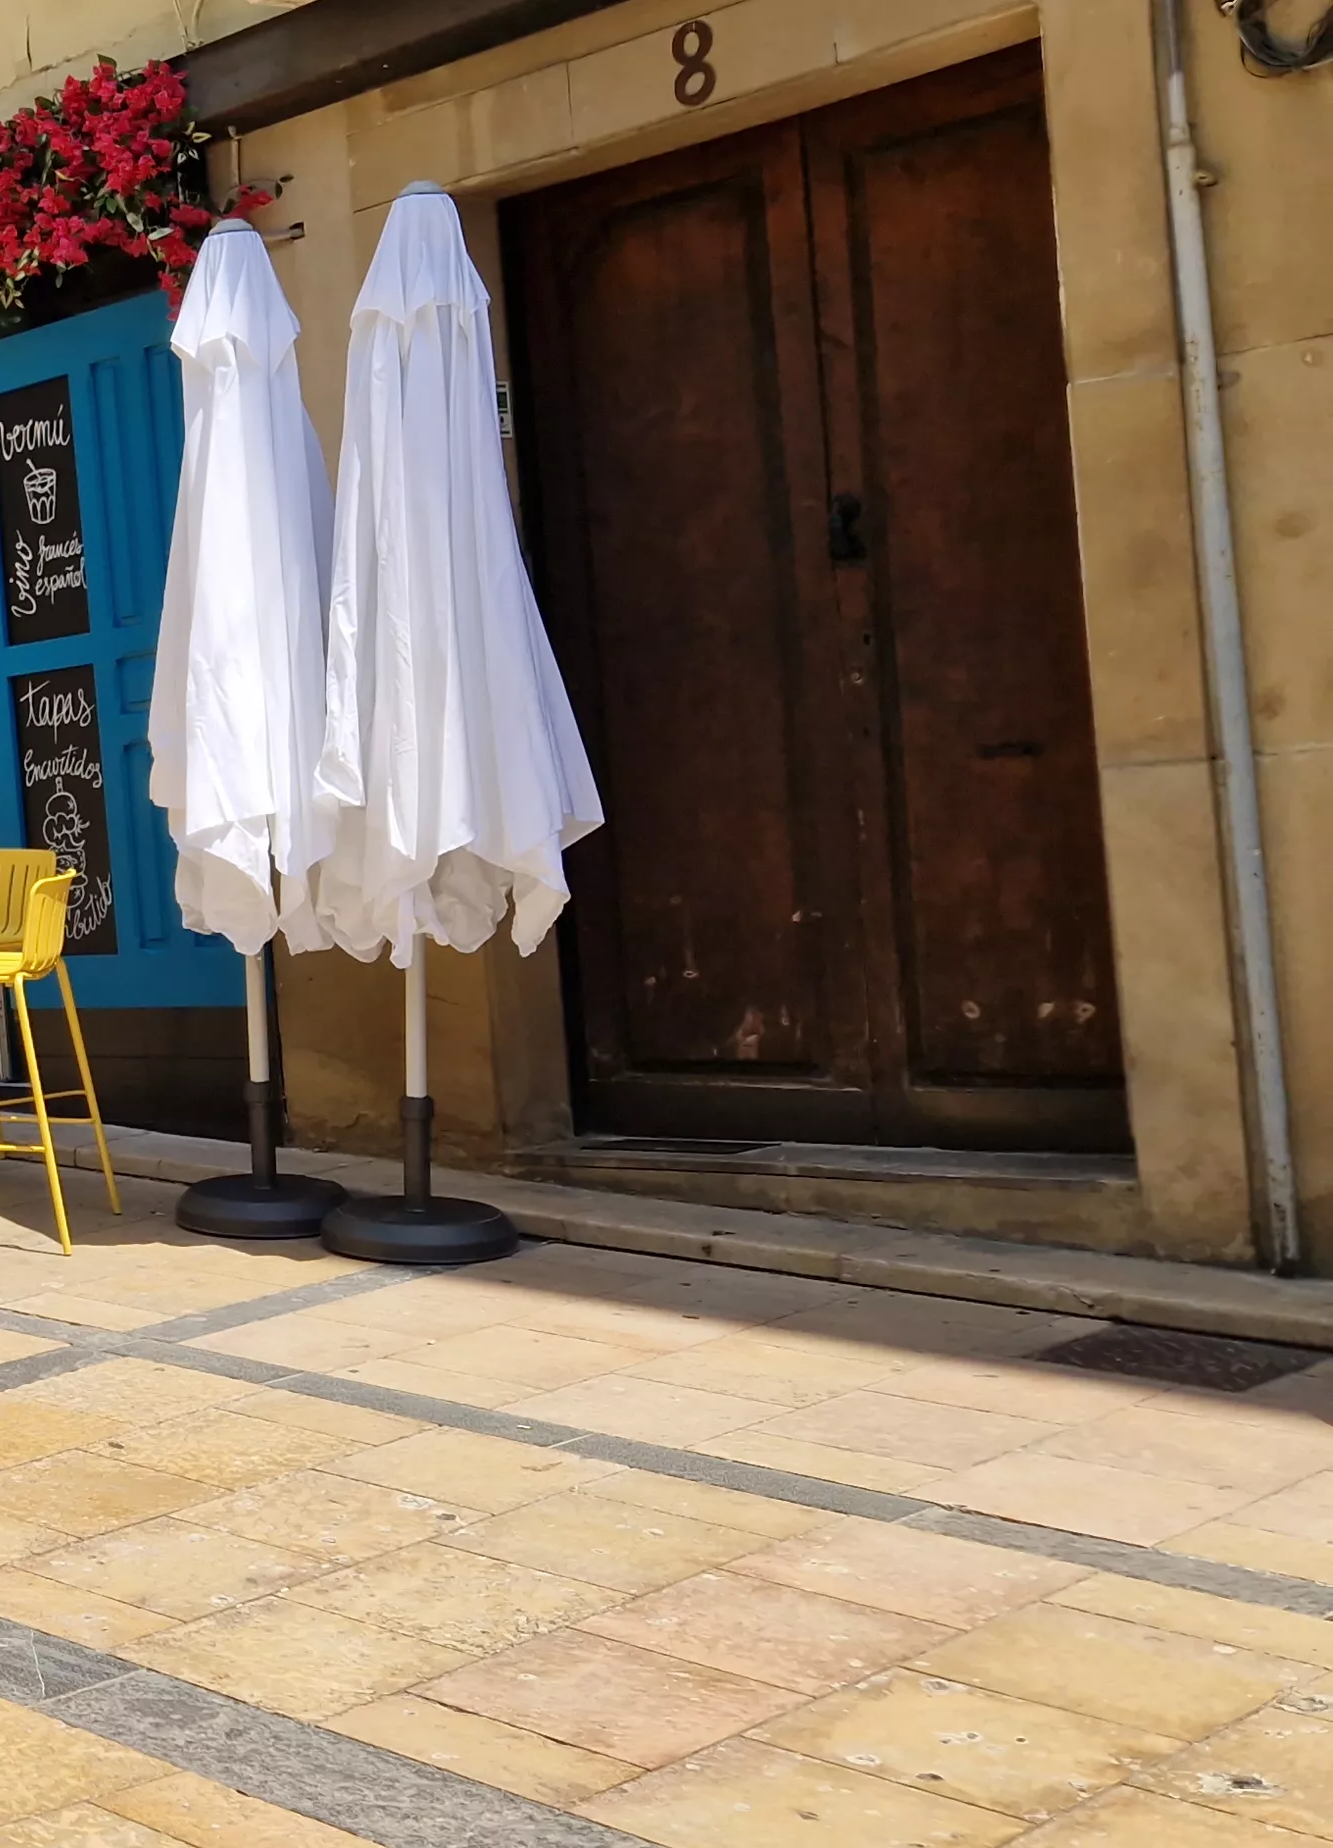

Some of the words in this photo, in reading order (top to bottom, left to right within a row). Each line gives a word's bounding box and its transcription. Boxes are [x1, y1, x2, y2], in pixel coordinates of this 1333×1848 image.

[671, 20, 717, 107] 8
[35, 556, 89, 606] español
[23, 744, 104, 788] Encurtidos
[64, 872, 113, 940] butido
